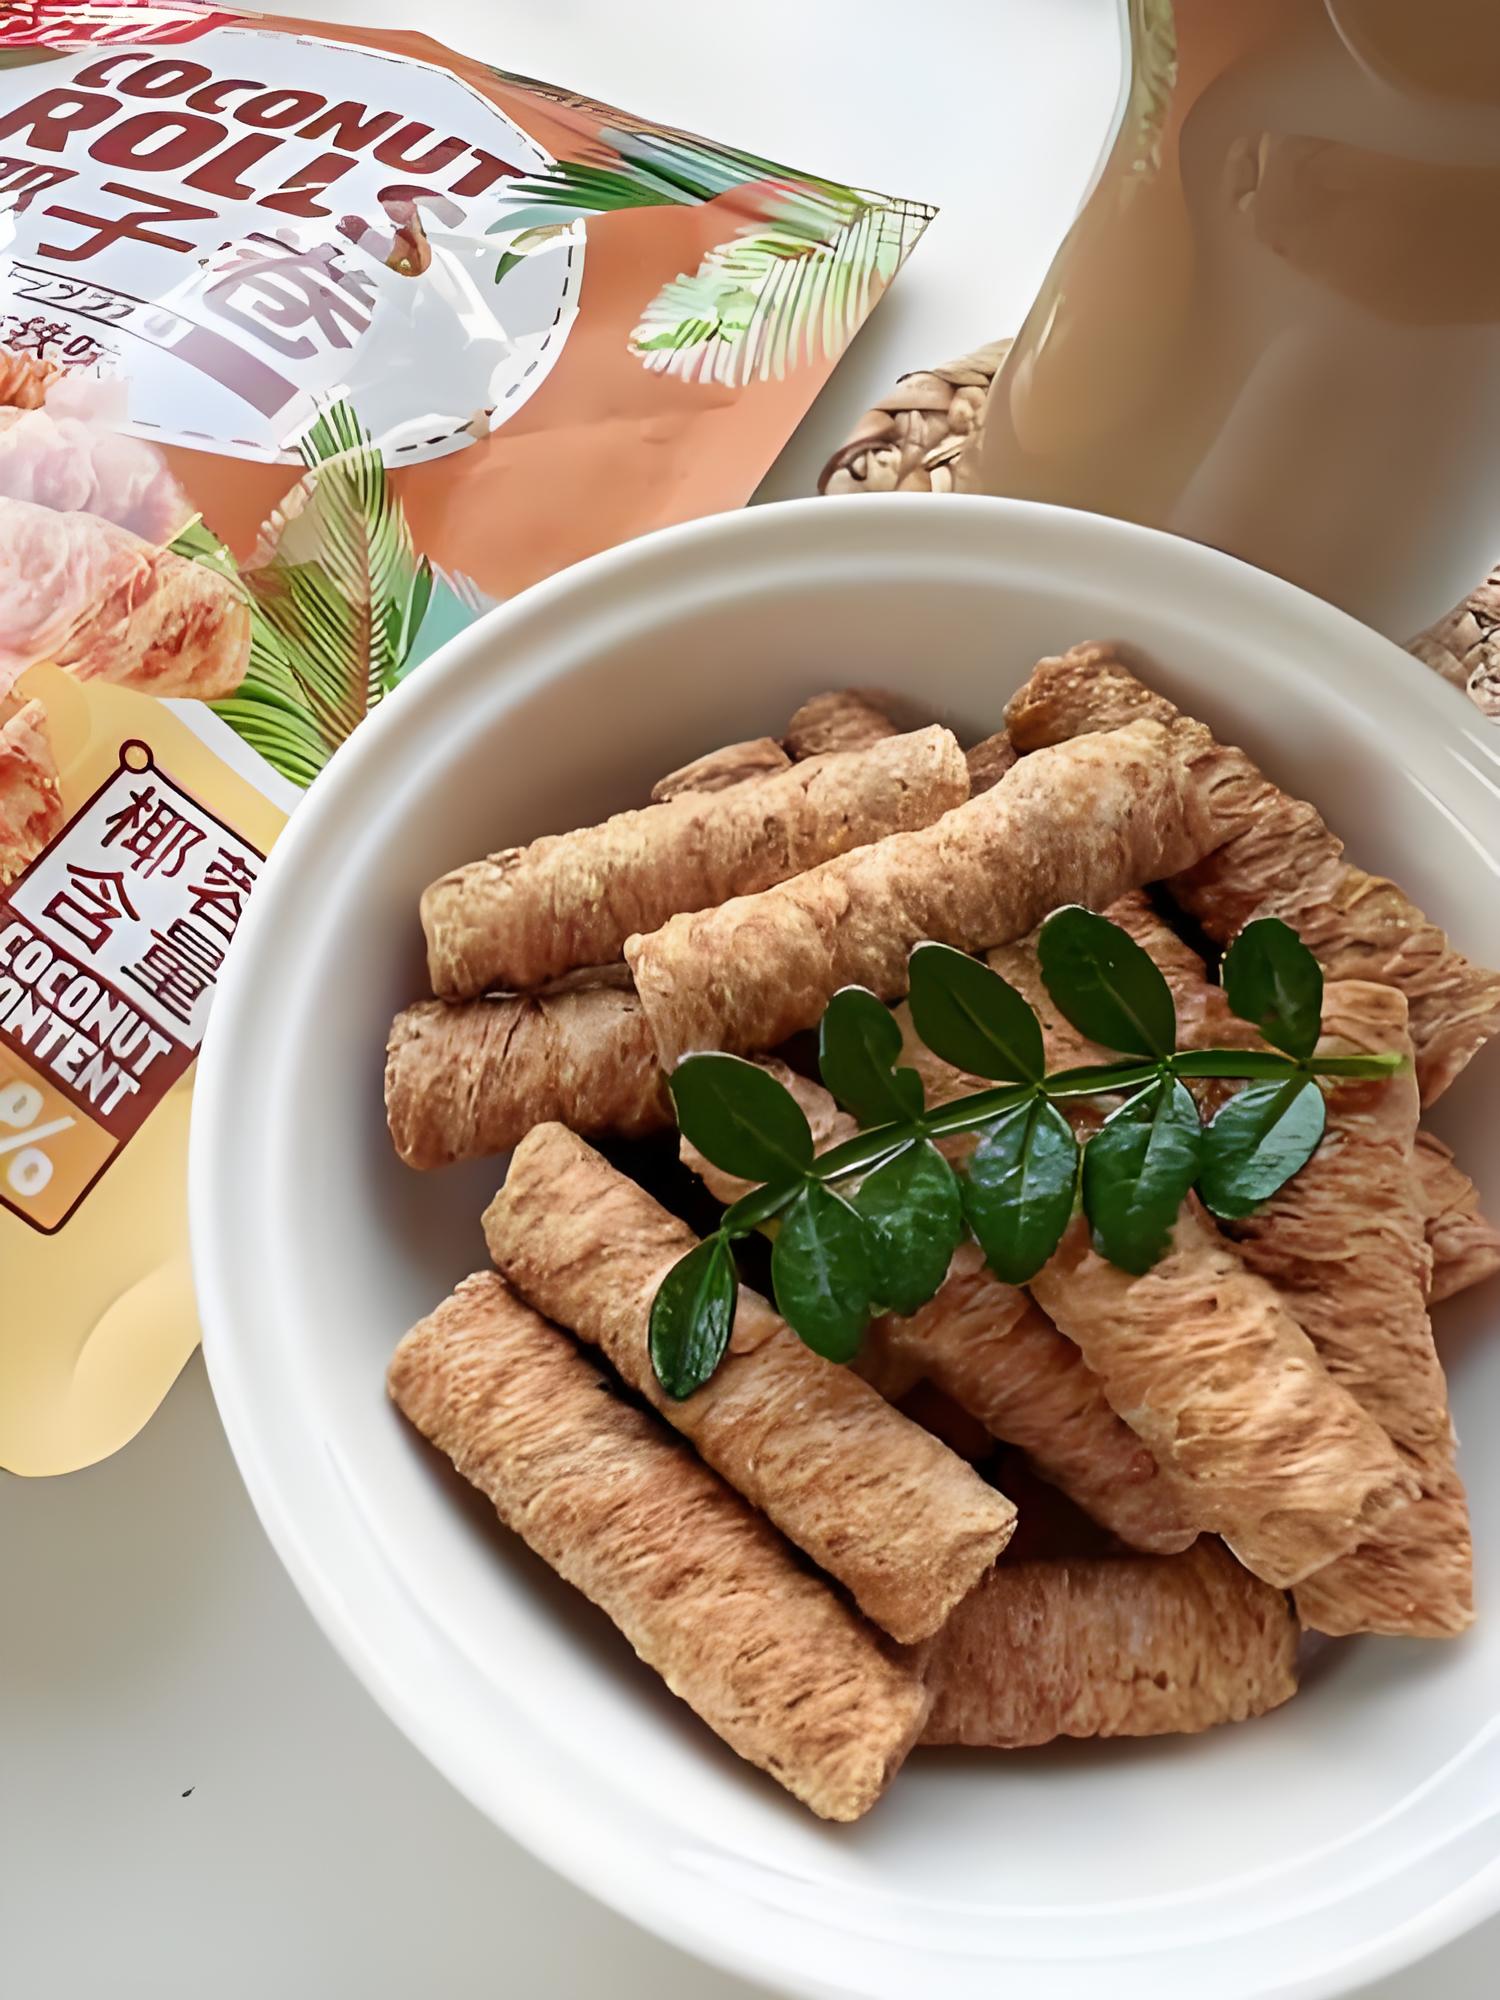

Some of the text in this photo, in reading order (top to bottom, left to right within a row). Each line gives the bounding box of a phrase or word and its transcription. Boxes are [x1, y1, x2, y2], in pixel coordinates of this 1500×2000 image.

[0, 88, 467, 277] ROLLS
[73, 53, 527, 197] COCONUT
[0, 921, 173, 1076] COCONUT
[0, 970, 141, 1116] ONTENT
